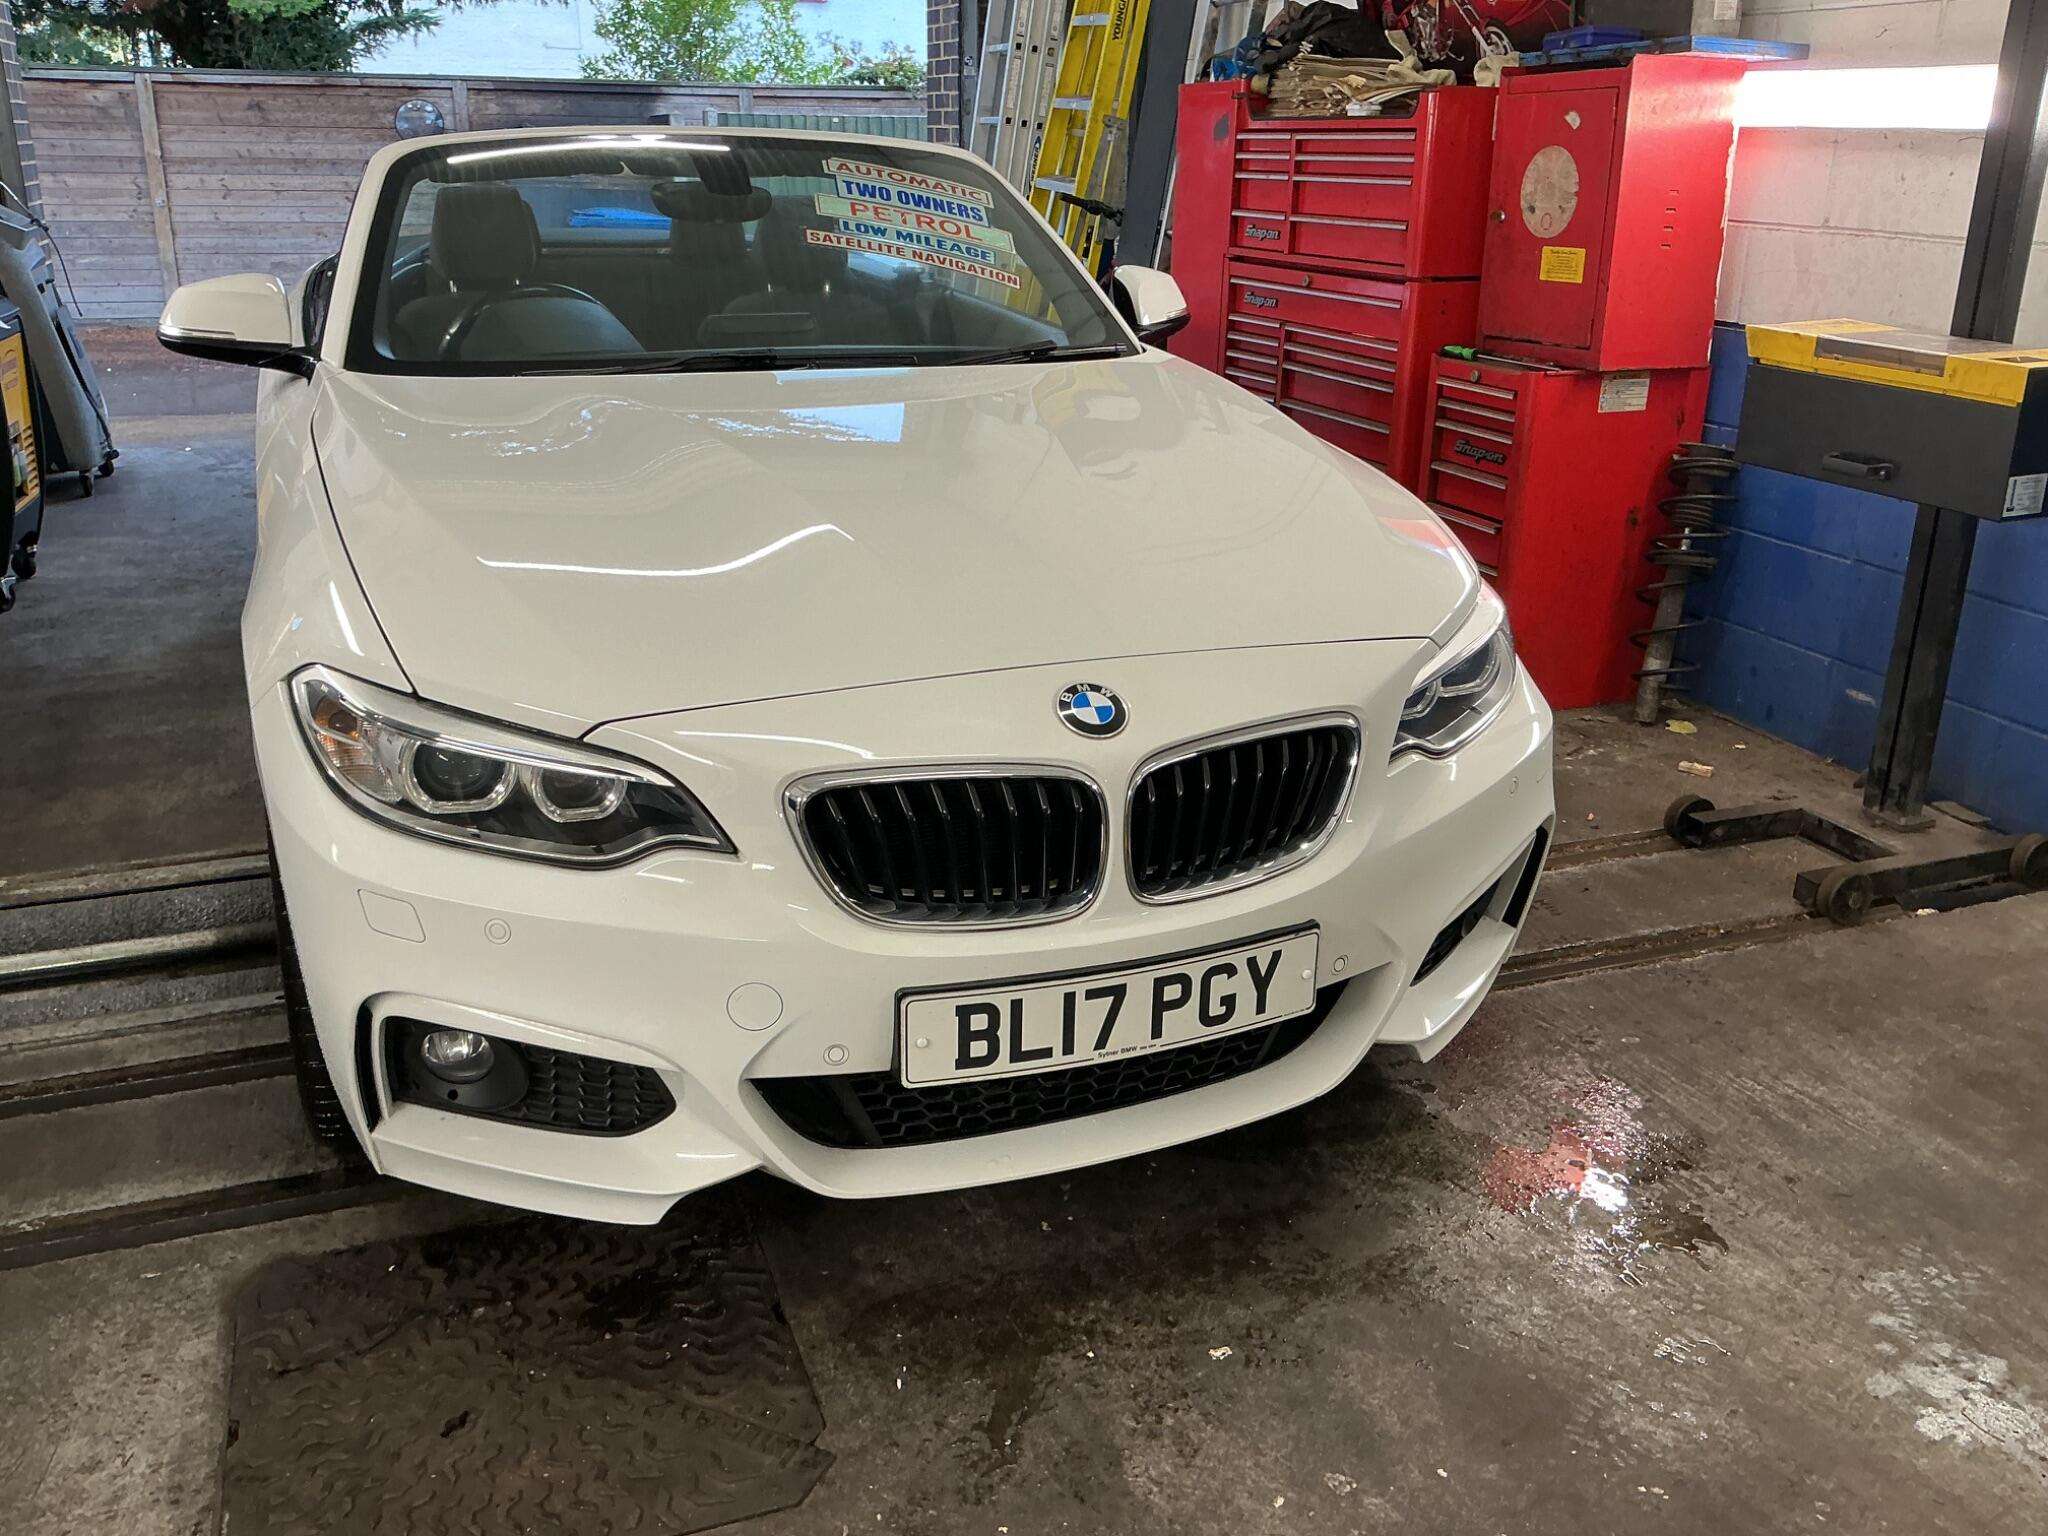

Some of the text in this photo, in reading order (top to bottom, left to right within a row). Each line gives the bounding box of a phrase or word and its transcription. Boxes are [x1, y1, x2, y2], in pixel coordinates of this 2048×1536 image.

[836, 163, 983, 201] AUTOMATIC
[843, 180, 984, 222] TWO OWNERS
[843, 220, 992, 262] LOW MILEAGE
[850, 202, 984, 242] PETROL
[810, 232, 1019, 286] SATELLITE NAVIGATION
[1061, 684, 1114, 703] BMW
[954, 949, 1283, 1071] BL17 PGY
